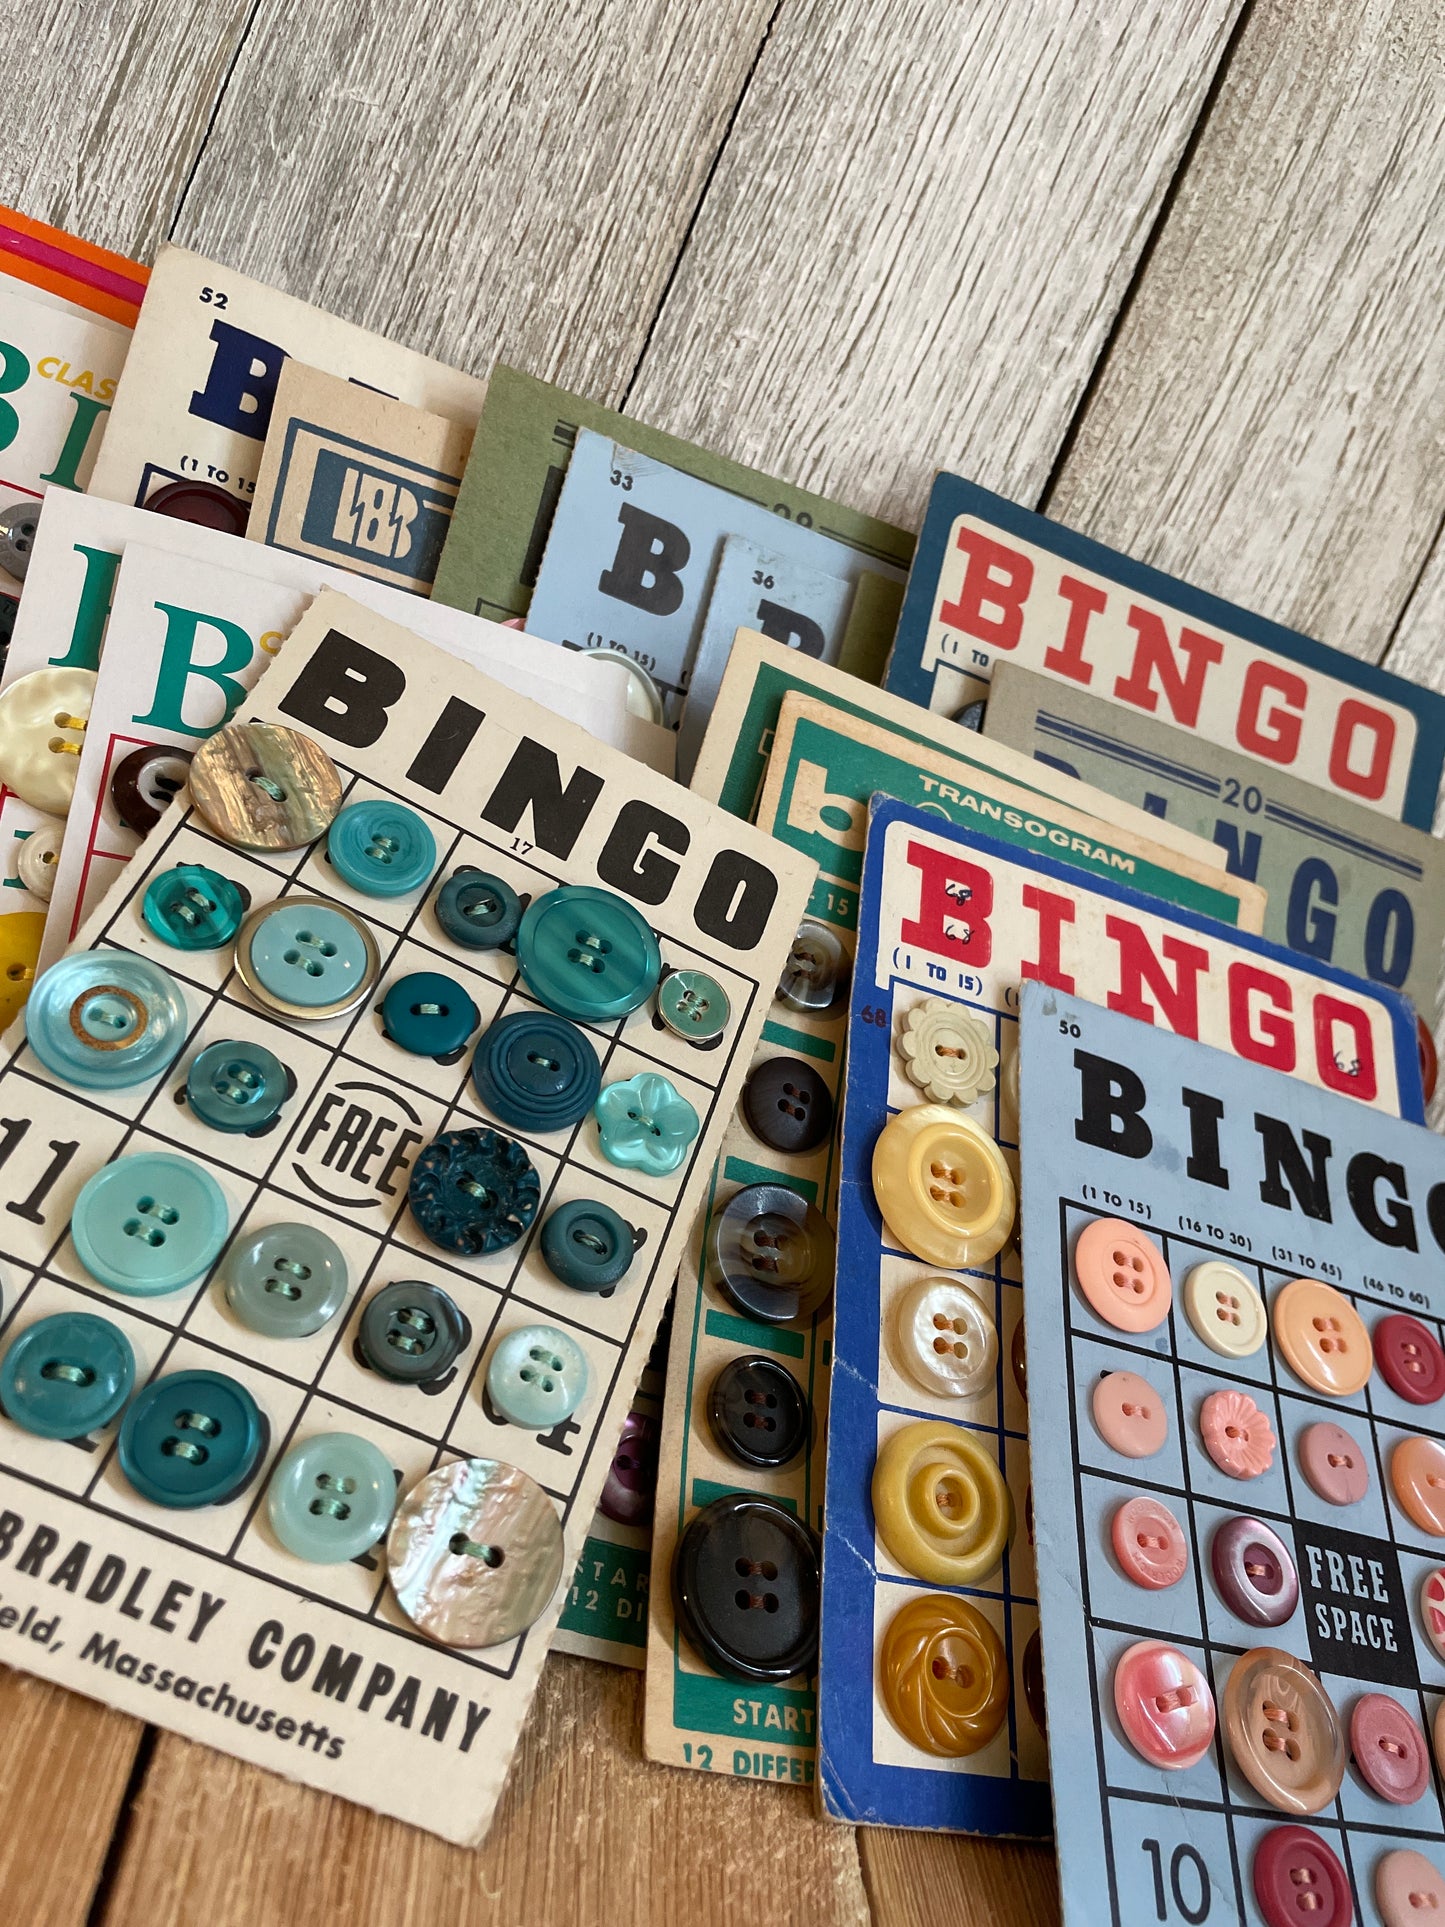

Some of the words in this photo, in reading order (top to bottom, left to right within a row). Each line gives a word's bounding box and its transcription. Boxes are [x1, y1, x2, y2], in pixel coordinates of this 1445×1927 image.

[199, 287, 228, 310] 52
[36, 357, 118, 400] CLAS
[207, 464, 229, 483] TO
[610, 470, 633, 491] 33
[599, 502, 692, 617] B
[752, 570, 774, 589] 36
[939, 526, 1396, 802] BINGO
[972, 649, 989, 667] TO
[278, 628, 778, 950] BINGO
[1222, 778, 1262, 815] 20
[919, 774, 1135, 875] TRANSOGRAM
[510, 837, 534, 856] 17
[827, 893, 848, 915] 15
[901, 840, 1377, 1102] BINGO
[926, 962, 947, 981] TO
[861, 1005, 887, 1028] 68
[1059, 1020, 1081, 1039] 50
[297, 1092, 423, 1197] FREE
[1103, 1191, 1122, 1207] TO
[1128, 1199, 1151, 1219] 15)
[1178, 1216, 1202, 1233] (16
[1206, 1224, 1224, 1240] TO
[1229, 1232, 1252, 1252] 30)
[1272, 1246, 1292, 1262] (31
[1298, 1254, 1316, 1270] TO
[1320, 1262, 1343, 1281] 45)
[1363, 1276, 1384, 1292] (46
[1388, 1283, 1405, 1299] TO
[1409, 1290, 1431, 1309] 60)
[1305, 1544, 1390, 1604] FREE
[0, 1509, 226, 1644] BRADLEY
[248, 1619, 491, 1754] COMPANY
[1315, 1603, 1399, 1653] SPACE
[80, 1631, 345, 1760] Massachusetts
[733, 1698, 814, 1733] START
[683, 1742, 713, 1771] 12
[1141, 1838, 1212, 1926] 10
